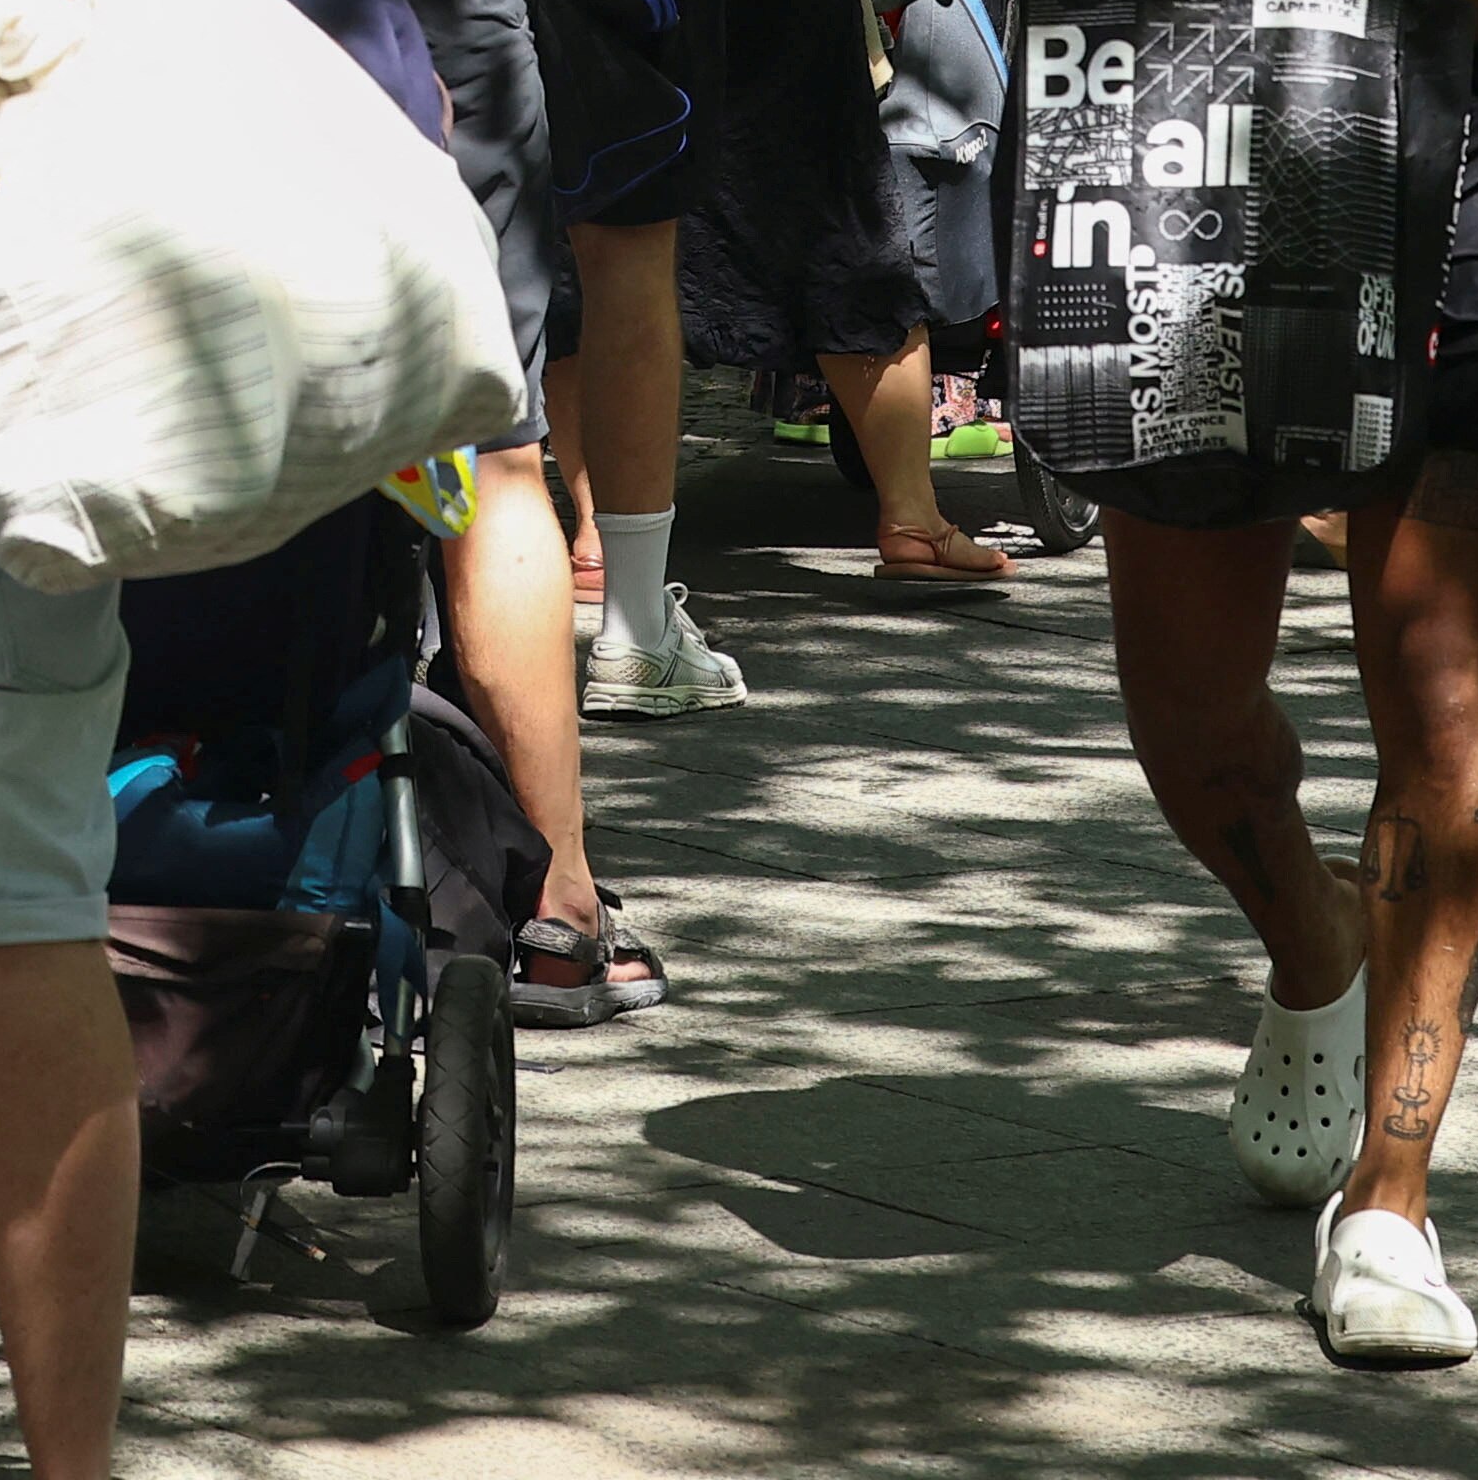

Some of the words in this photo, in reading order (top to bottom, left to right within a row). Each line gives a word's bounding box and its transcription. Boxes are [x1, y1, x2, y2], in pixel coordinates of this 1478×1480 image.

[1026, 24, 1135, 108] Be
[1142, 103, 1254, 188] all
[1125, 265, 1161, 377] MOST
[1214, 305, 1245, 414] LEAST
[1139, 419, 1184, 438] SWEAT
[1188, 415, 1227, 428] ONCE
[1153, 432, 1179, 445] DAY
[1183, 428, 1201, 439] TO
